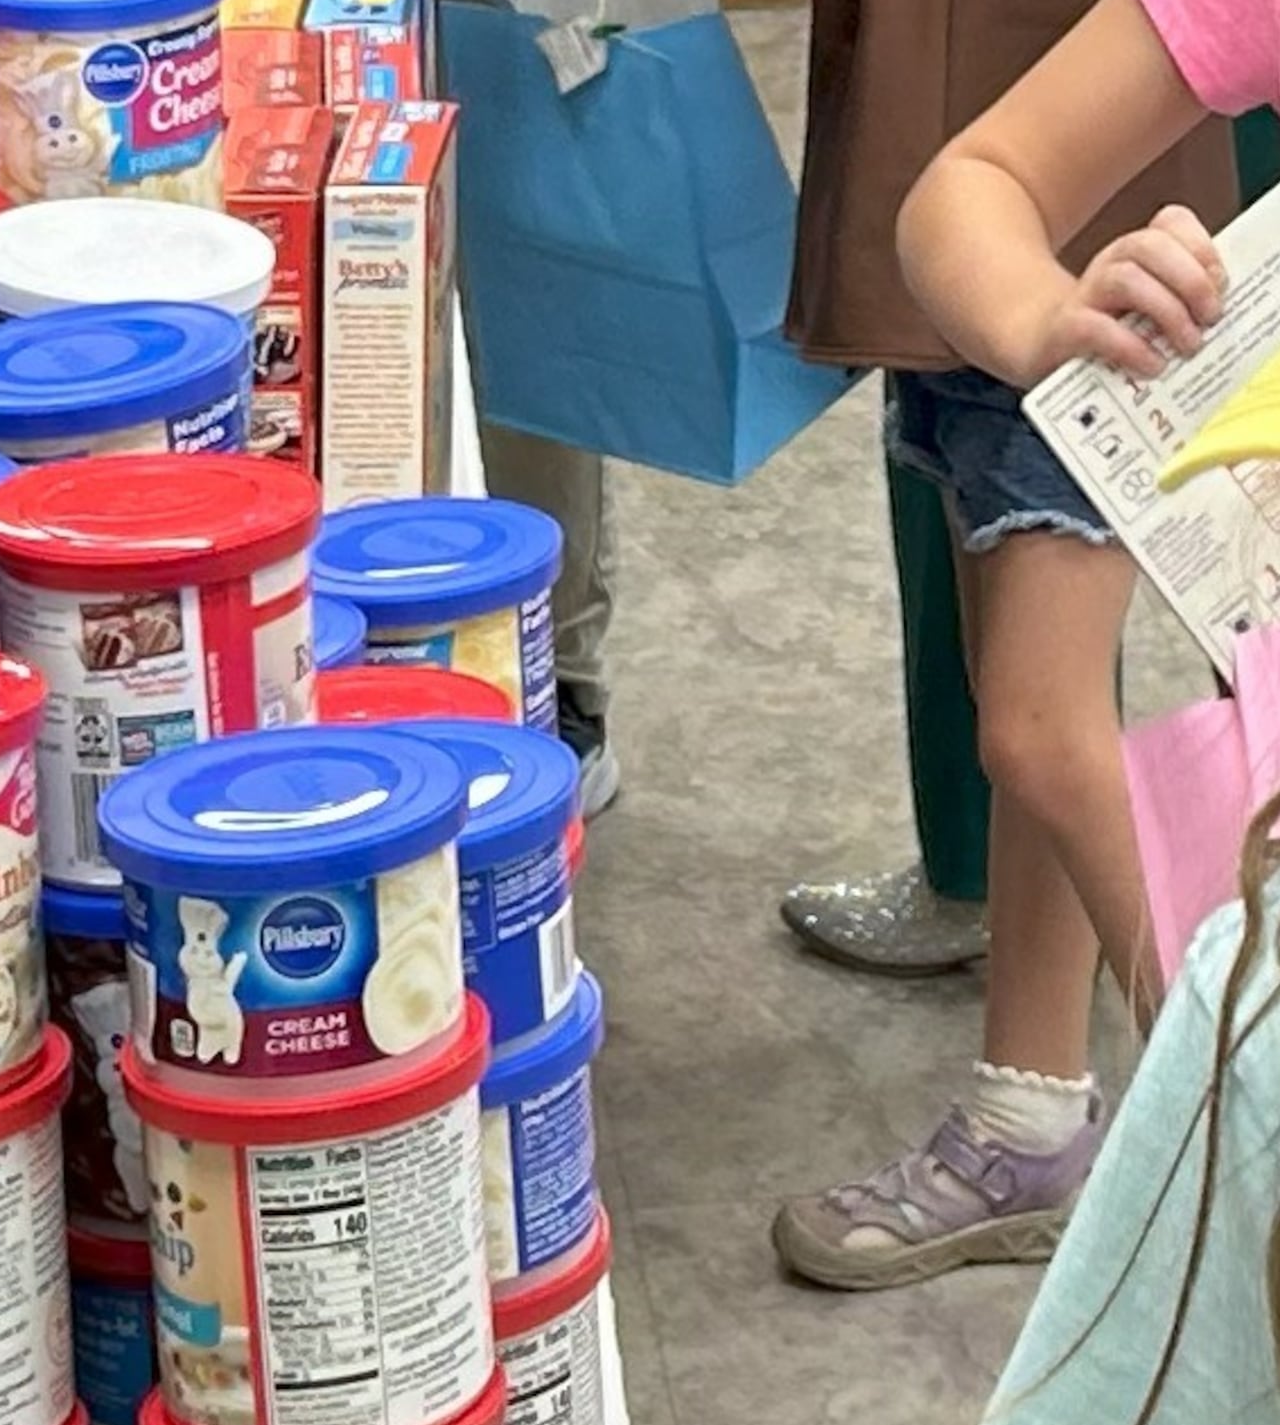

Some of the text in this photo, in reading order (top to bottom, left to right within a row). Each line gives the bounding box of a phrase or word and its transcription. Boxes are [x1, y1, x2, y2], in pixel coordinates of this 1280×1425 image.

[263, 924, 345, 952] Pillsbury
[267, 1011, 347, 1037] CREAM
[264, 1029, 351, 1056] CHEESE
[325, 1146, 362, 1166] Facts
[261, 1211, 368, 1244] Calories 140
